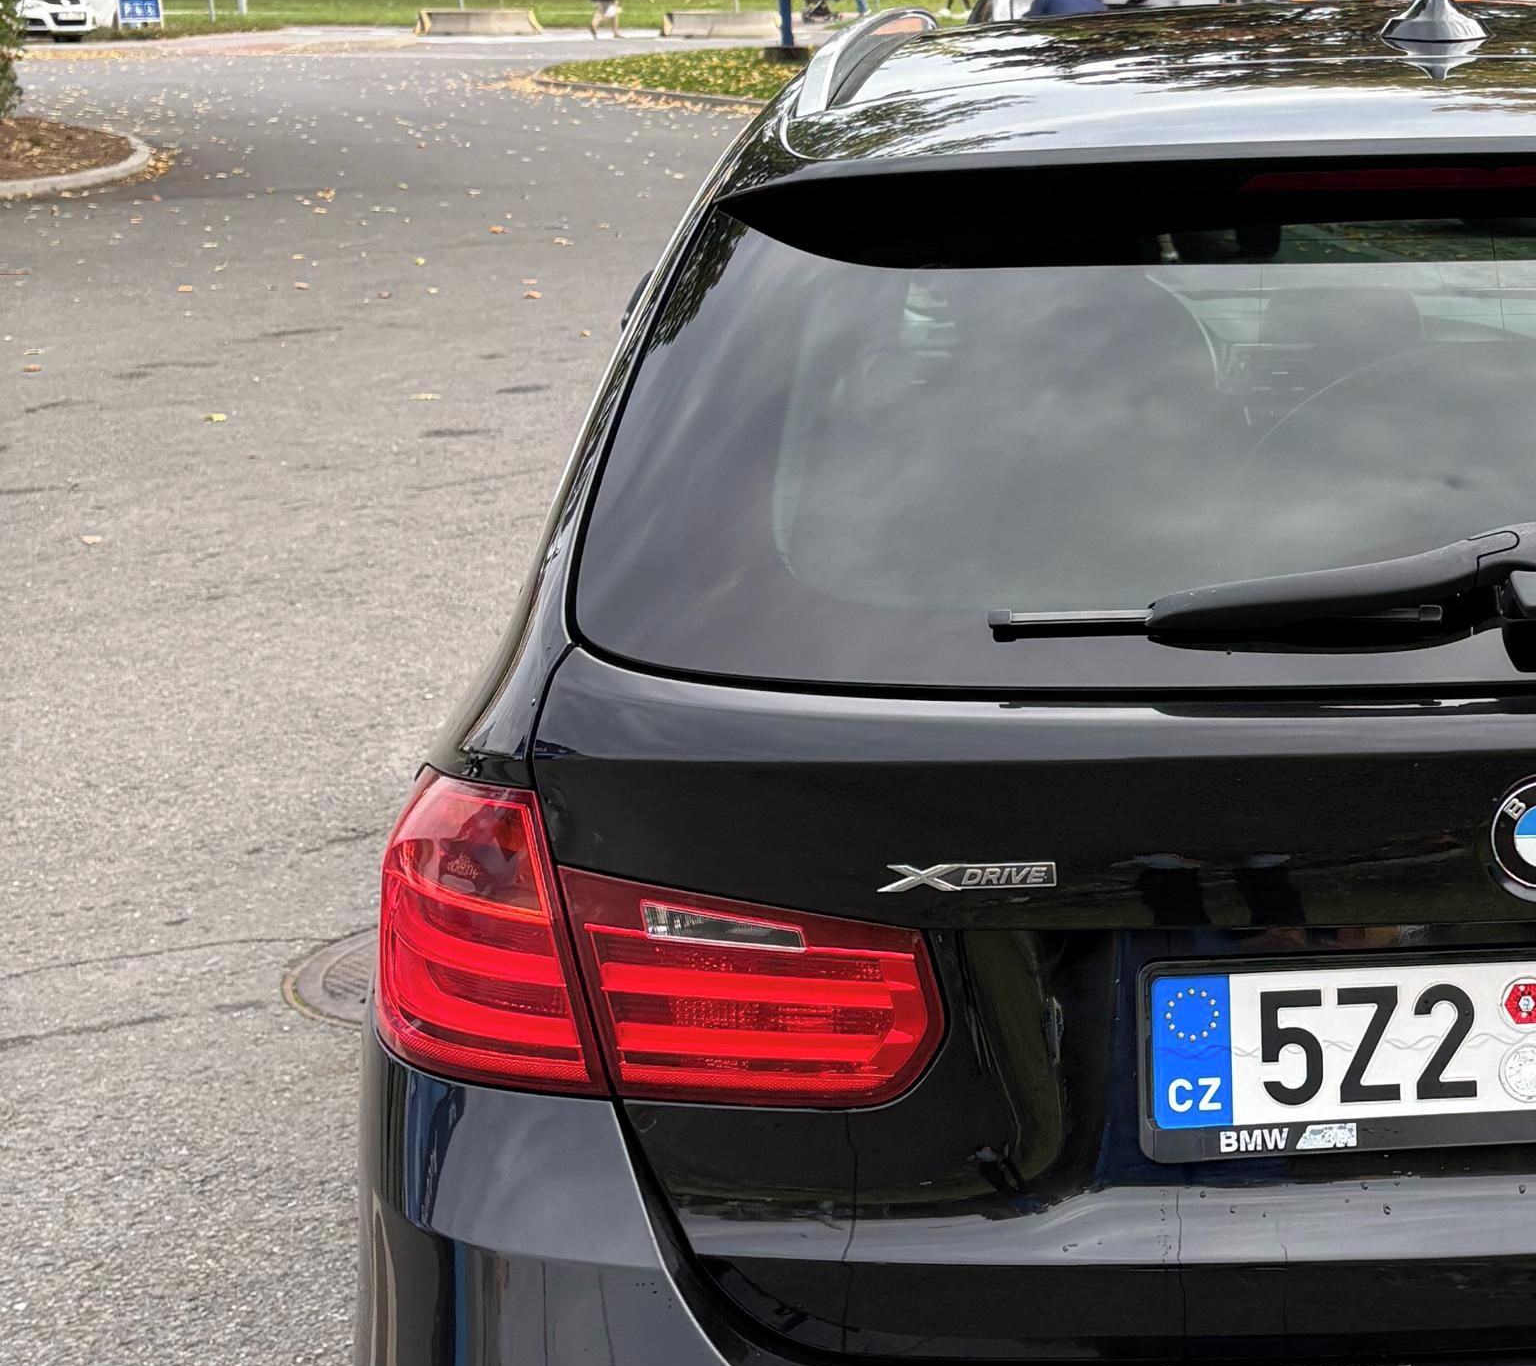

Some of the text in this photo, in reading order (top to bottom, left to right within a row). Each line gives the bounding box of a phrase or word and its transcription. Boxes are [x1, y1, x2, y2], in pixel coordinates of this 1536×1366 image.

[1167, 1077, 1222, 1112] CZ
[1260, 983, 1478, 1106] 5Z2
[1219, 1128, 1289, 1153] BMW
